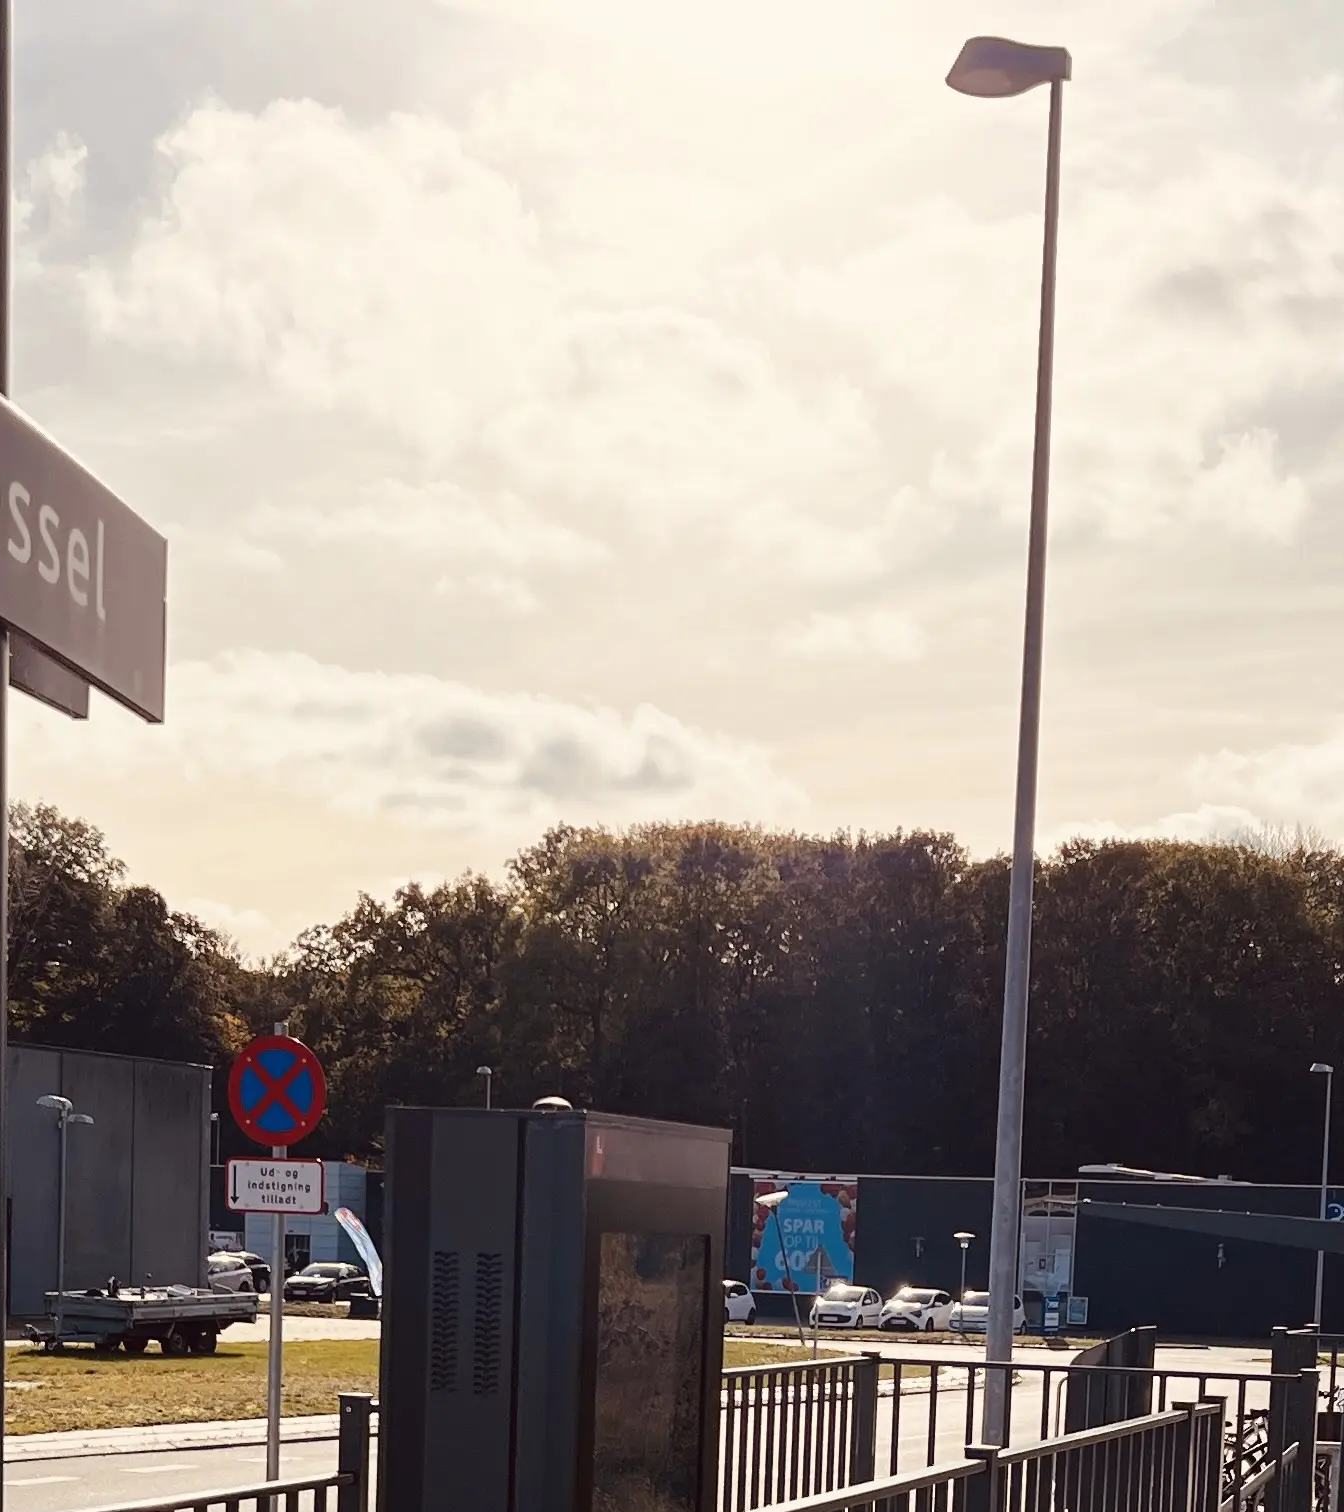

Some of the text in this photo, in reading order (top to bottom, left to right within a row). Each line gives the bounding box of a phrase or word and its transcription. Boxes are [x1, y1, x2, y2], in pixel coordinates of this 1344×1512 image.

[285, 1169, 299, 1179] og
[247, 1180, 311, 1193] indstigning
[261, 1194, 297, 1204] tilladt
[783, 1218, 825, 1235] SPAR
[784, 1235, 803, 1249] OP
